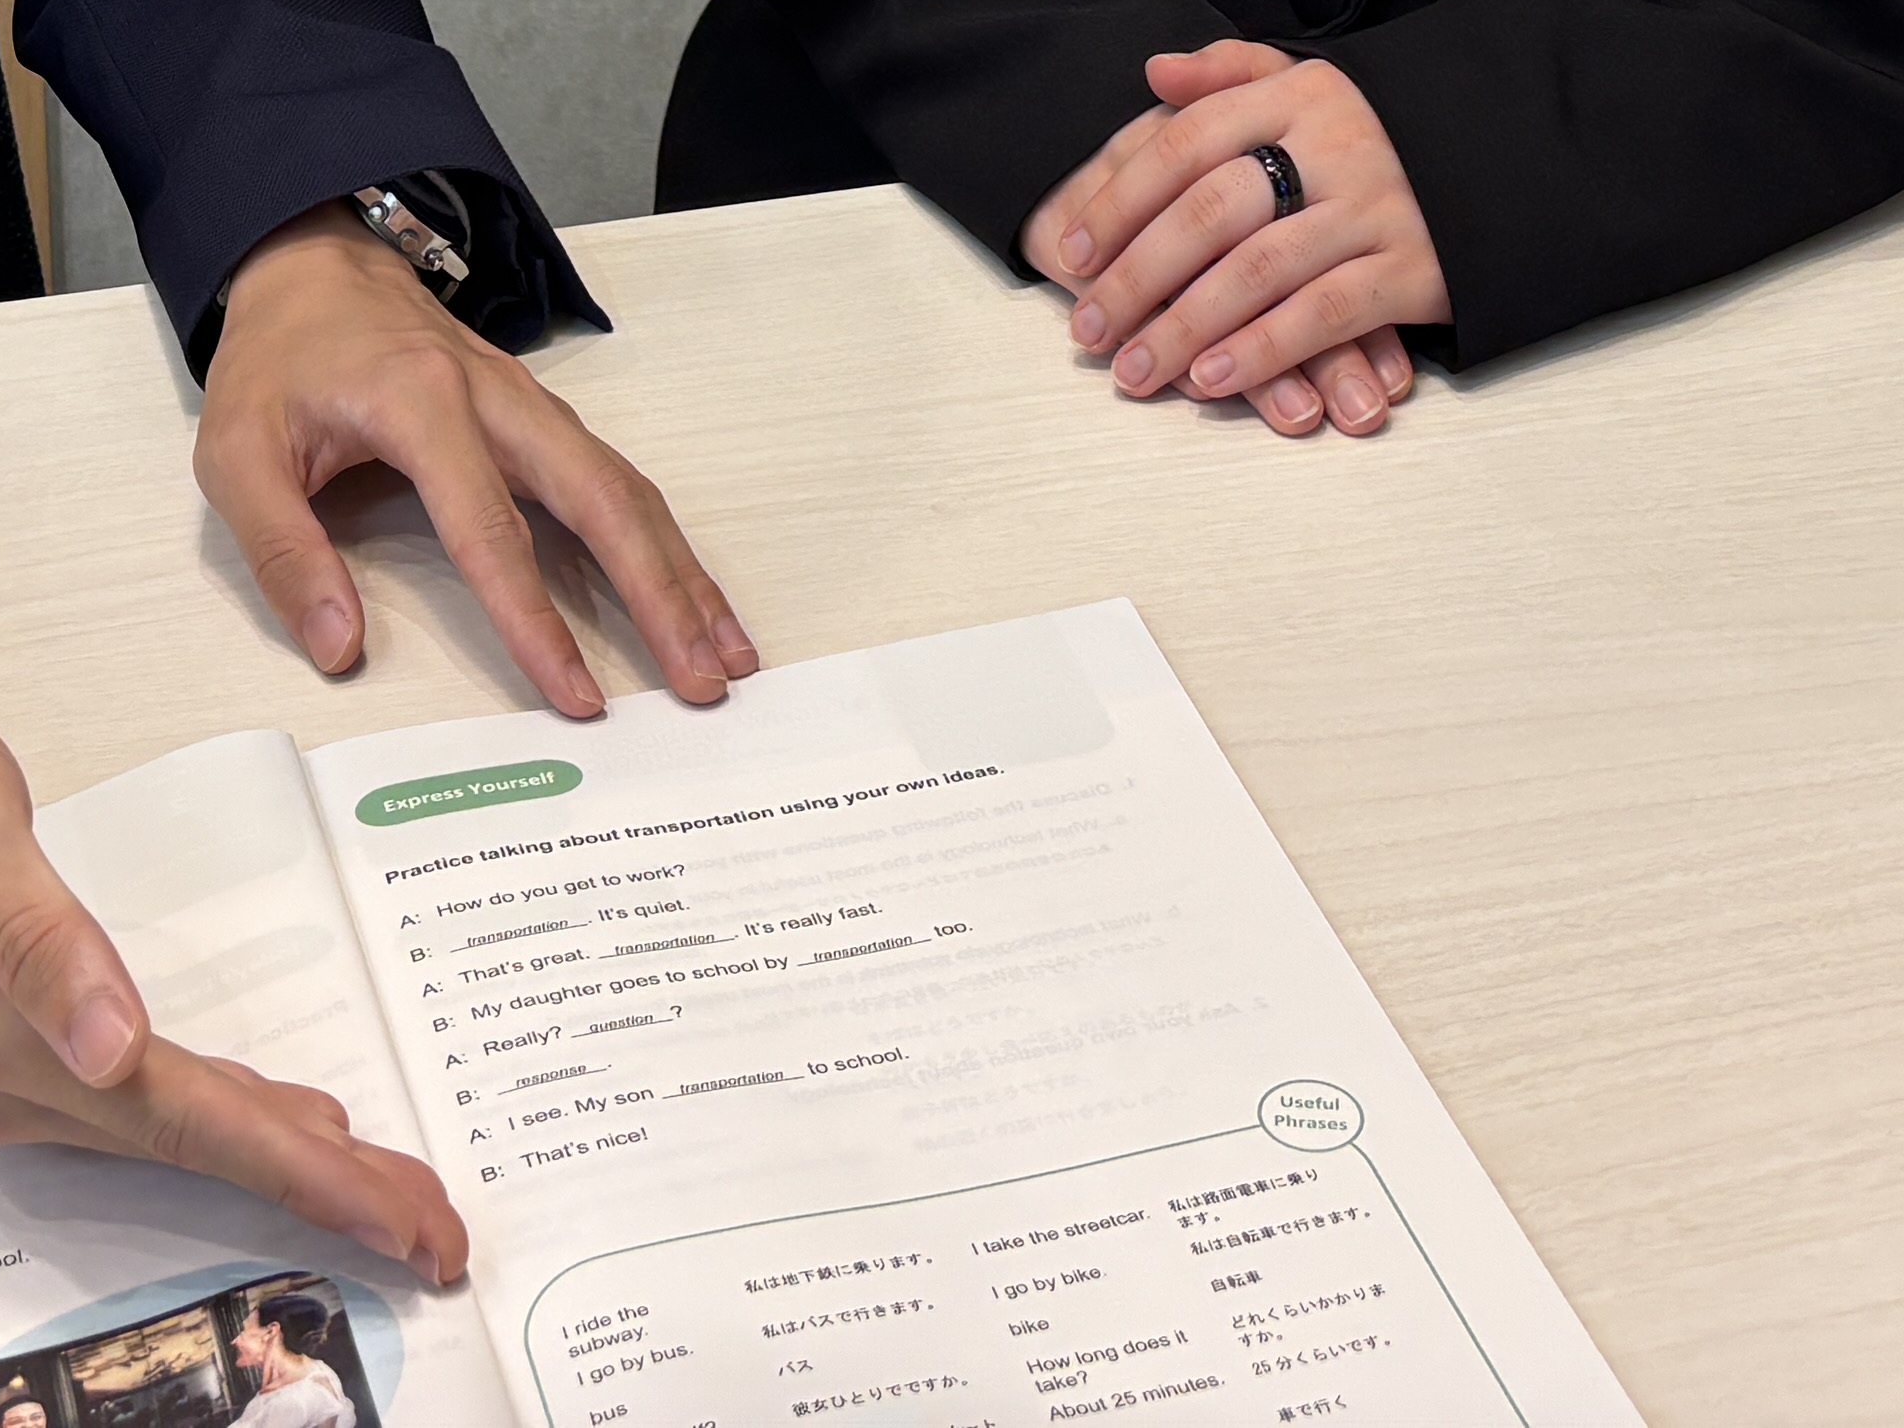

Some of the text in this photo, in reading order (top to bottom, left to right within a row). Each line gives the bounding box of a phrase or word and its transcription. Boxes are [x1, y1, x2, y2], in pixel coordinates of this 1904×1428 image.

[383, 771, 555, 812] Express Yourself
[385, 766, 1005, 885] Practice talking about transportation using your own ideas.
[400, 864, 685, 930] A: How do you get to work?
[409, 947, 432, 963] B:
[597, 907, 629, 922] It's
[634, 899, 690, 918] quiet.
[422, 981, 444, 998] A:
[457, 961, 524, 984] That's
[530, 948, 591, 972] great.
[744, 922, 775, 936] It's
[780, 912, 833, 931] really
[838, 902, 883, 920] fast.
[432, 1017, 456, 1033] B:
[471, 1003, 502, 1020] My
[509, 983, 603, 1010] daughter
[609, 975, 661, 994] goes
[664, 971, 686, 983] to
[691, 958, 759, 979] school
[763, 956, 788, 970] by
[933, 923, 973, 937] too.
[445, 1053, 469, 1070] A:
[483, 1025, 562, 1056] Really?
[456, 1090, 480, 1106] B:
[470, 1127, 492, 1145] A:
[521, 1108, 569, 1126] see.
[574, 1097, 607, 1114] My
[613, 1089, 655, 1105] son
[807, 1062, 829, 1075] to
[834, 1046, 910, 1071] school.
[1279, 1095, 1340, 1111] Useful
[1273, 1114, 1348, 1132] Phrases
[480, 1126, 648, 1183] B: That's nice!
[982, 1237, 1025, 1253] take
[1028, 1229, 1060, 1245] the
[1063, 1210, 1151, 1237] streetcar.
[1004, 1283, 1029, 1300] go
[1032, 1277, 1056, 1292] by
[1060, 1268, 1107, 1285] bike.
[1210, 1270, 1263, 1293] 自転車
[575, 1315, 612, 1336] ride
[617, 1305, 649, 1323] the
[1008, 1320, 1050, 1337] bike
[568, 1326, 648, 1359] subway.
[1026, 1329, 1189, 1375] How long does it
[590, 1364, 615, 1384] go
[620, 1355, 644, 1372] by
[649, 1345, 694, 1364] bus.
[778, 1359, 813, 1377] バス
[1035, 1370, 1088, 1395] take?
[589, 1404, 628, 1428] bus
[1050, 1375, 1225, 1422] About 25 minutes.
